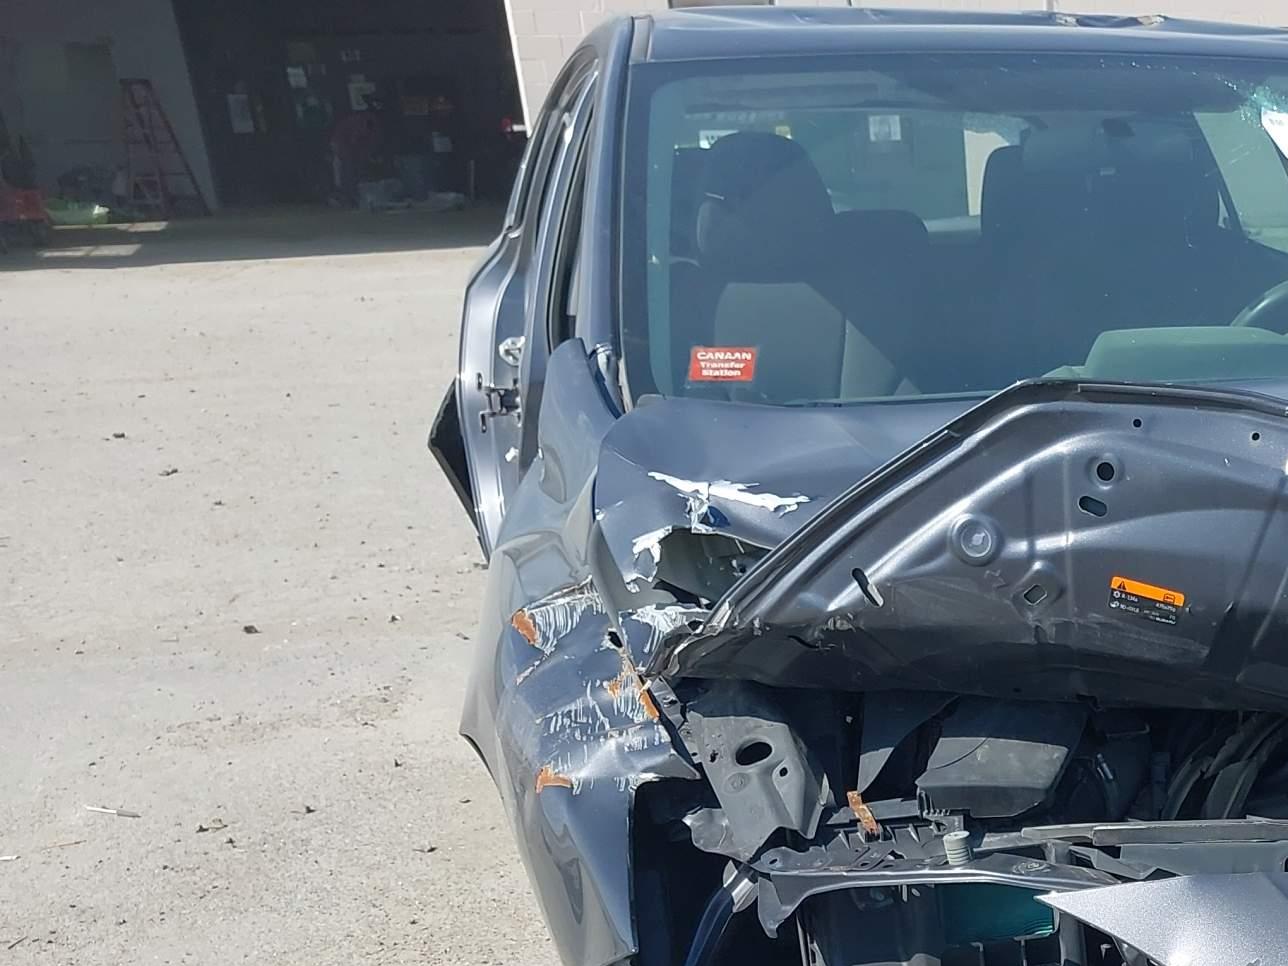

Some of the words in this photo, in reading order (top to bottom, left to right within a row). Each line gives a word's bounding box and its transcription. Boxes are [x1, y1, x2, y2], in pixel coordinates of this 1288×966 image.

[696, 351, 752, 361] CANAAN
[700, 361, 746, 369] Transfer
[701, 369, 742, 377] Station
